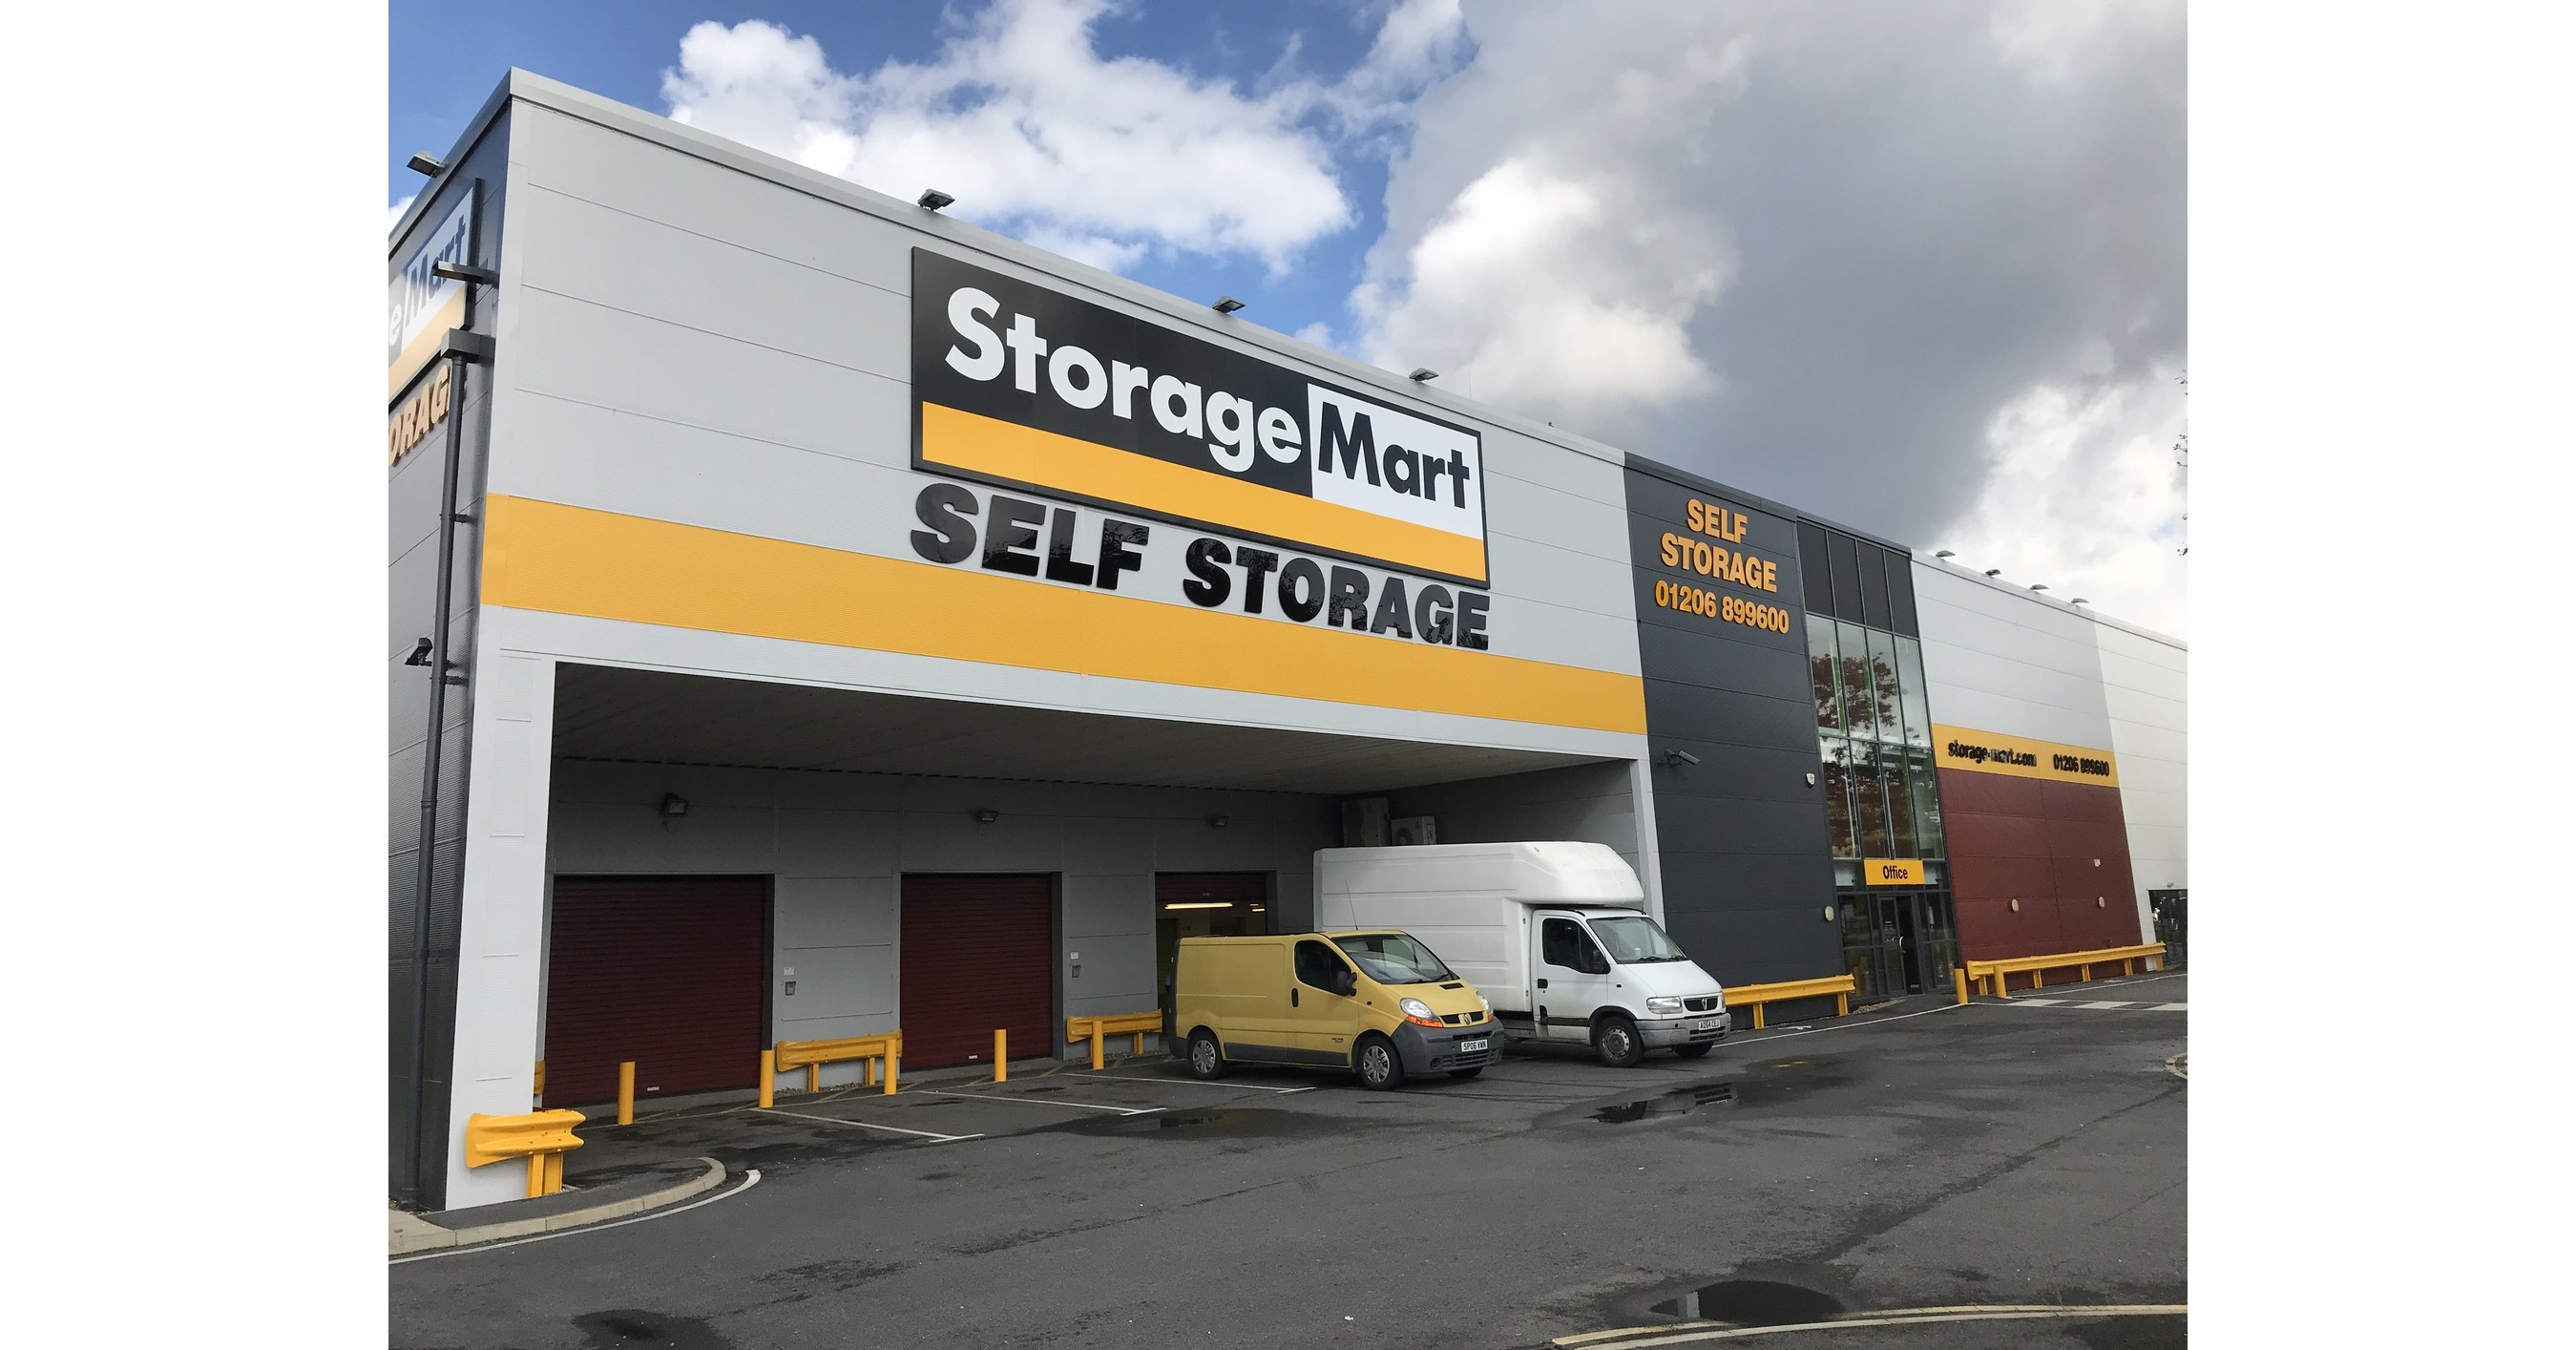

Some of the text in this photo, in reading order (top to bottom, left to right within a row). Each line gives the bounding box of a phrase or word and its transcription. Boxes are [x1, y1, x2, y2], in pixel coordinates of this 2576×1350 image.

[406, 214, 466, 328] Mart
[388, 365, 451, 467] ORAG
[945, 287, 1470, 509] Storage Mart
[1687, 498, 1748, 544] SELF
[911, 483, 1490, 650] SELF STORAGE
[1661, 532, 1777, 593] STORAGE
[1655, 580, 1790, 634] 01206 899600
[1948, 740, 2037, 767] storage-mart.com
[2053, 753, 2079, 772] 01206
[1882, 865, 1908, 879] Office
